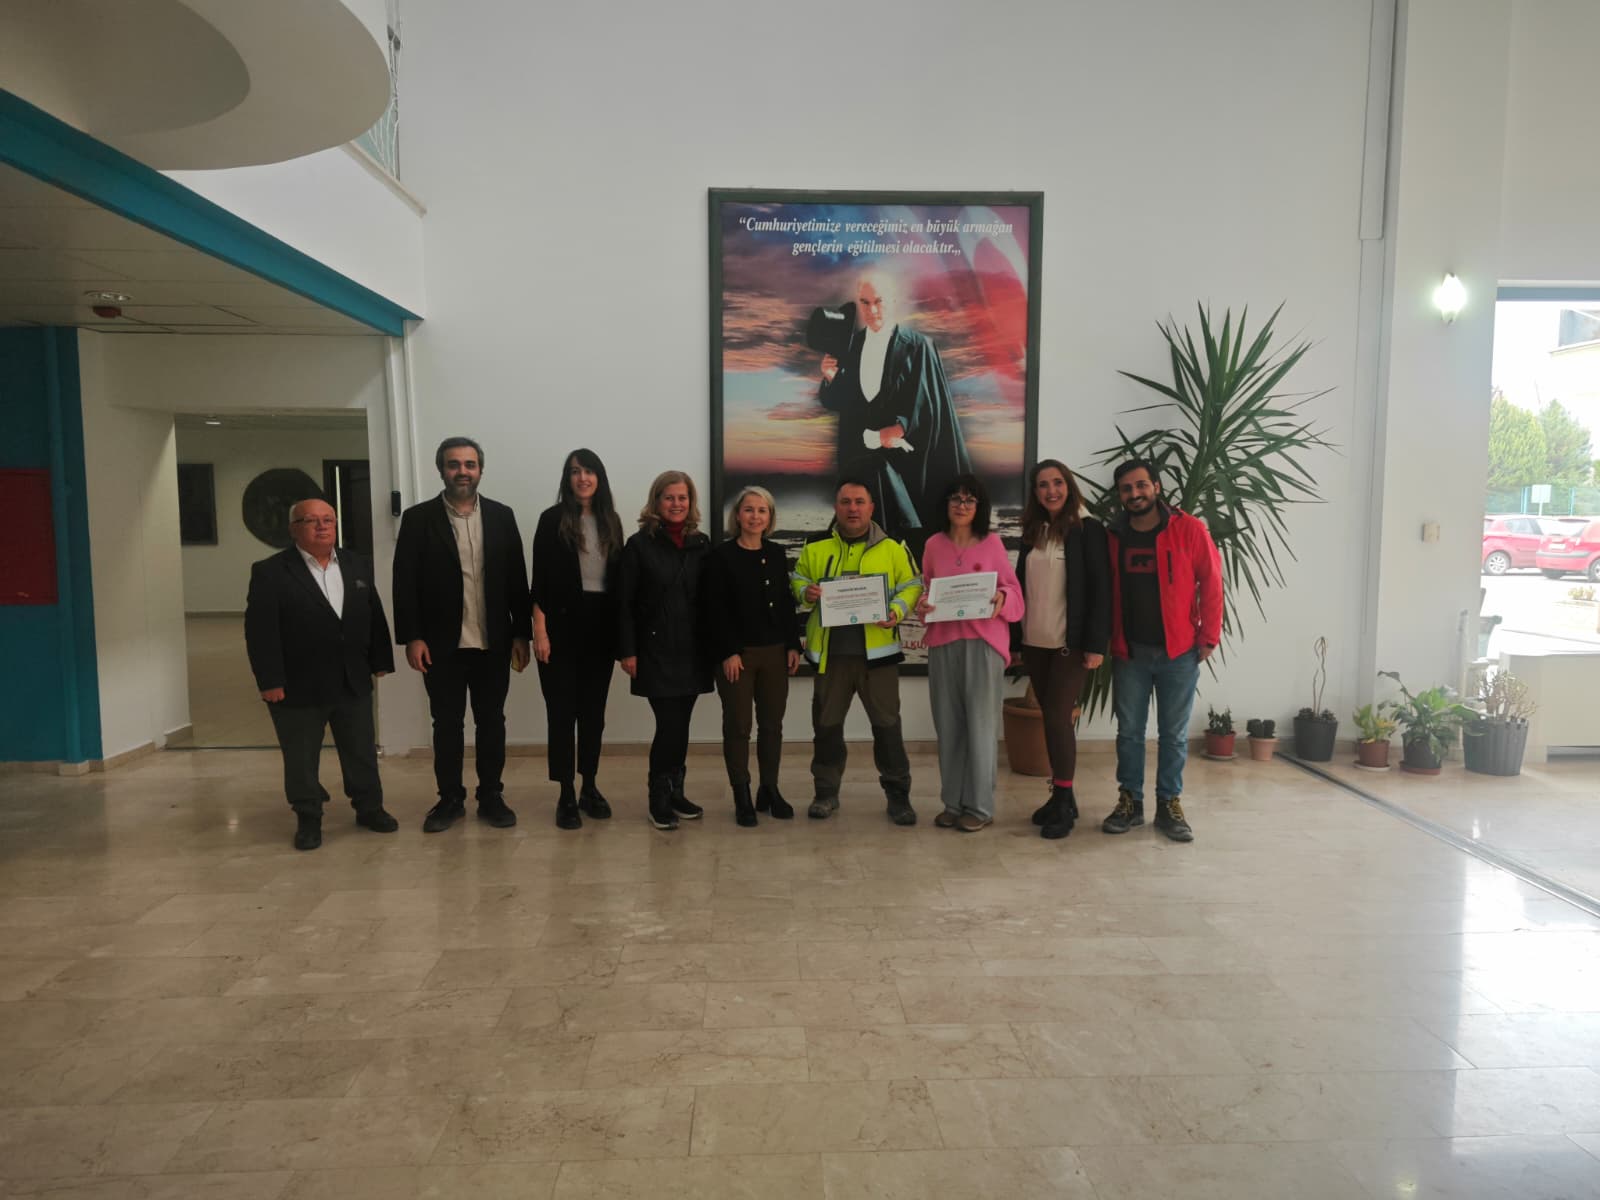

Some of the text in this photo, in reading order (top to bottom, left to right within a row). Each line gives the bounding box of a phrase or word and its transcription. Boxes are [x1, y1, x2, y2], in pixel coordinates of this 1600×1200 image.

[845, 219, 908, 236] vereceğimiz
[910, 223, 924, 233] en
[926, 219, 960, 236] büyük
[962, 221, 1013, 236] armağan
[792, 239, 843, 256] gençlerin
[847, 239, 900, 256] eğitilmesi
